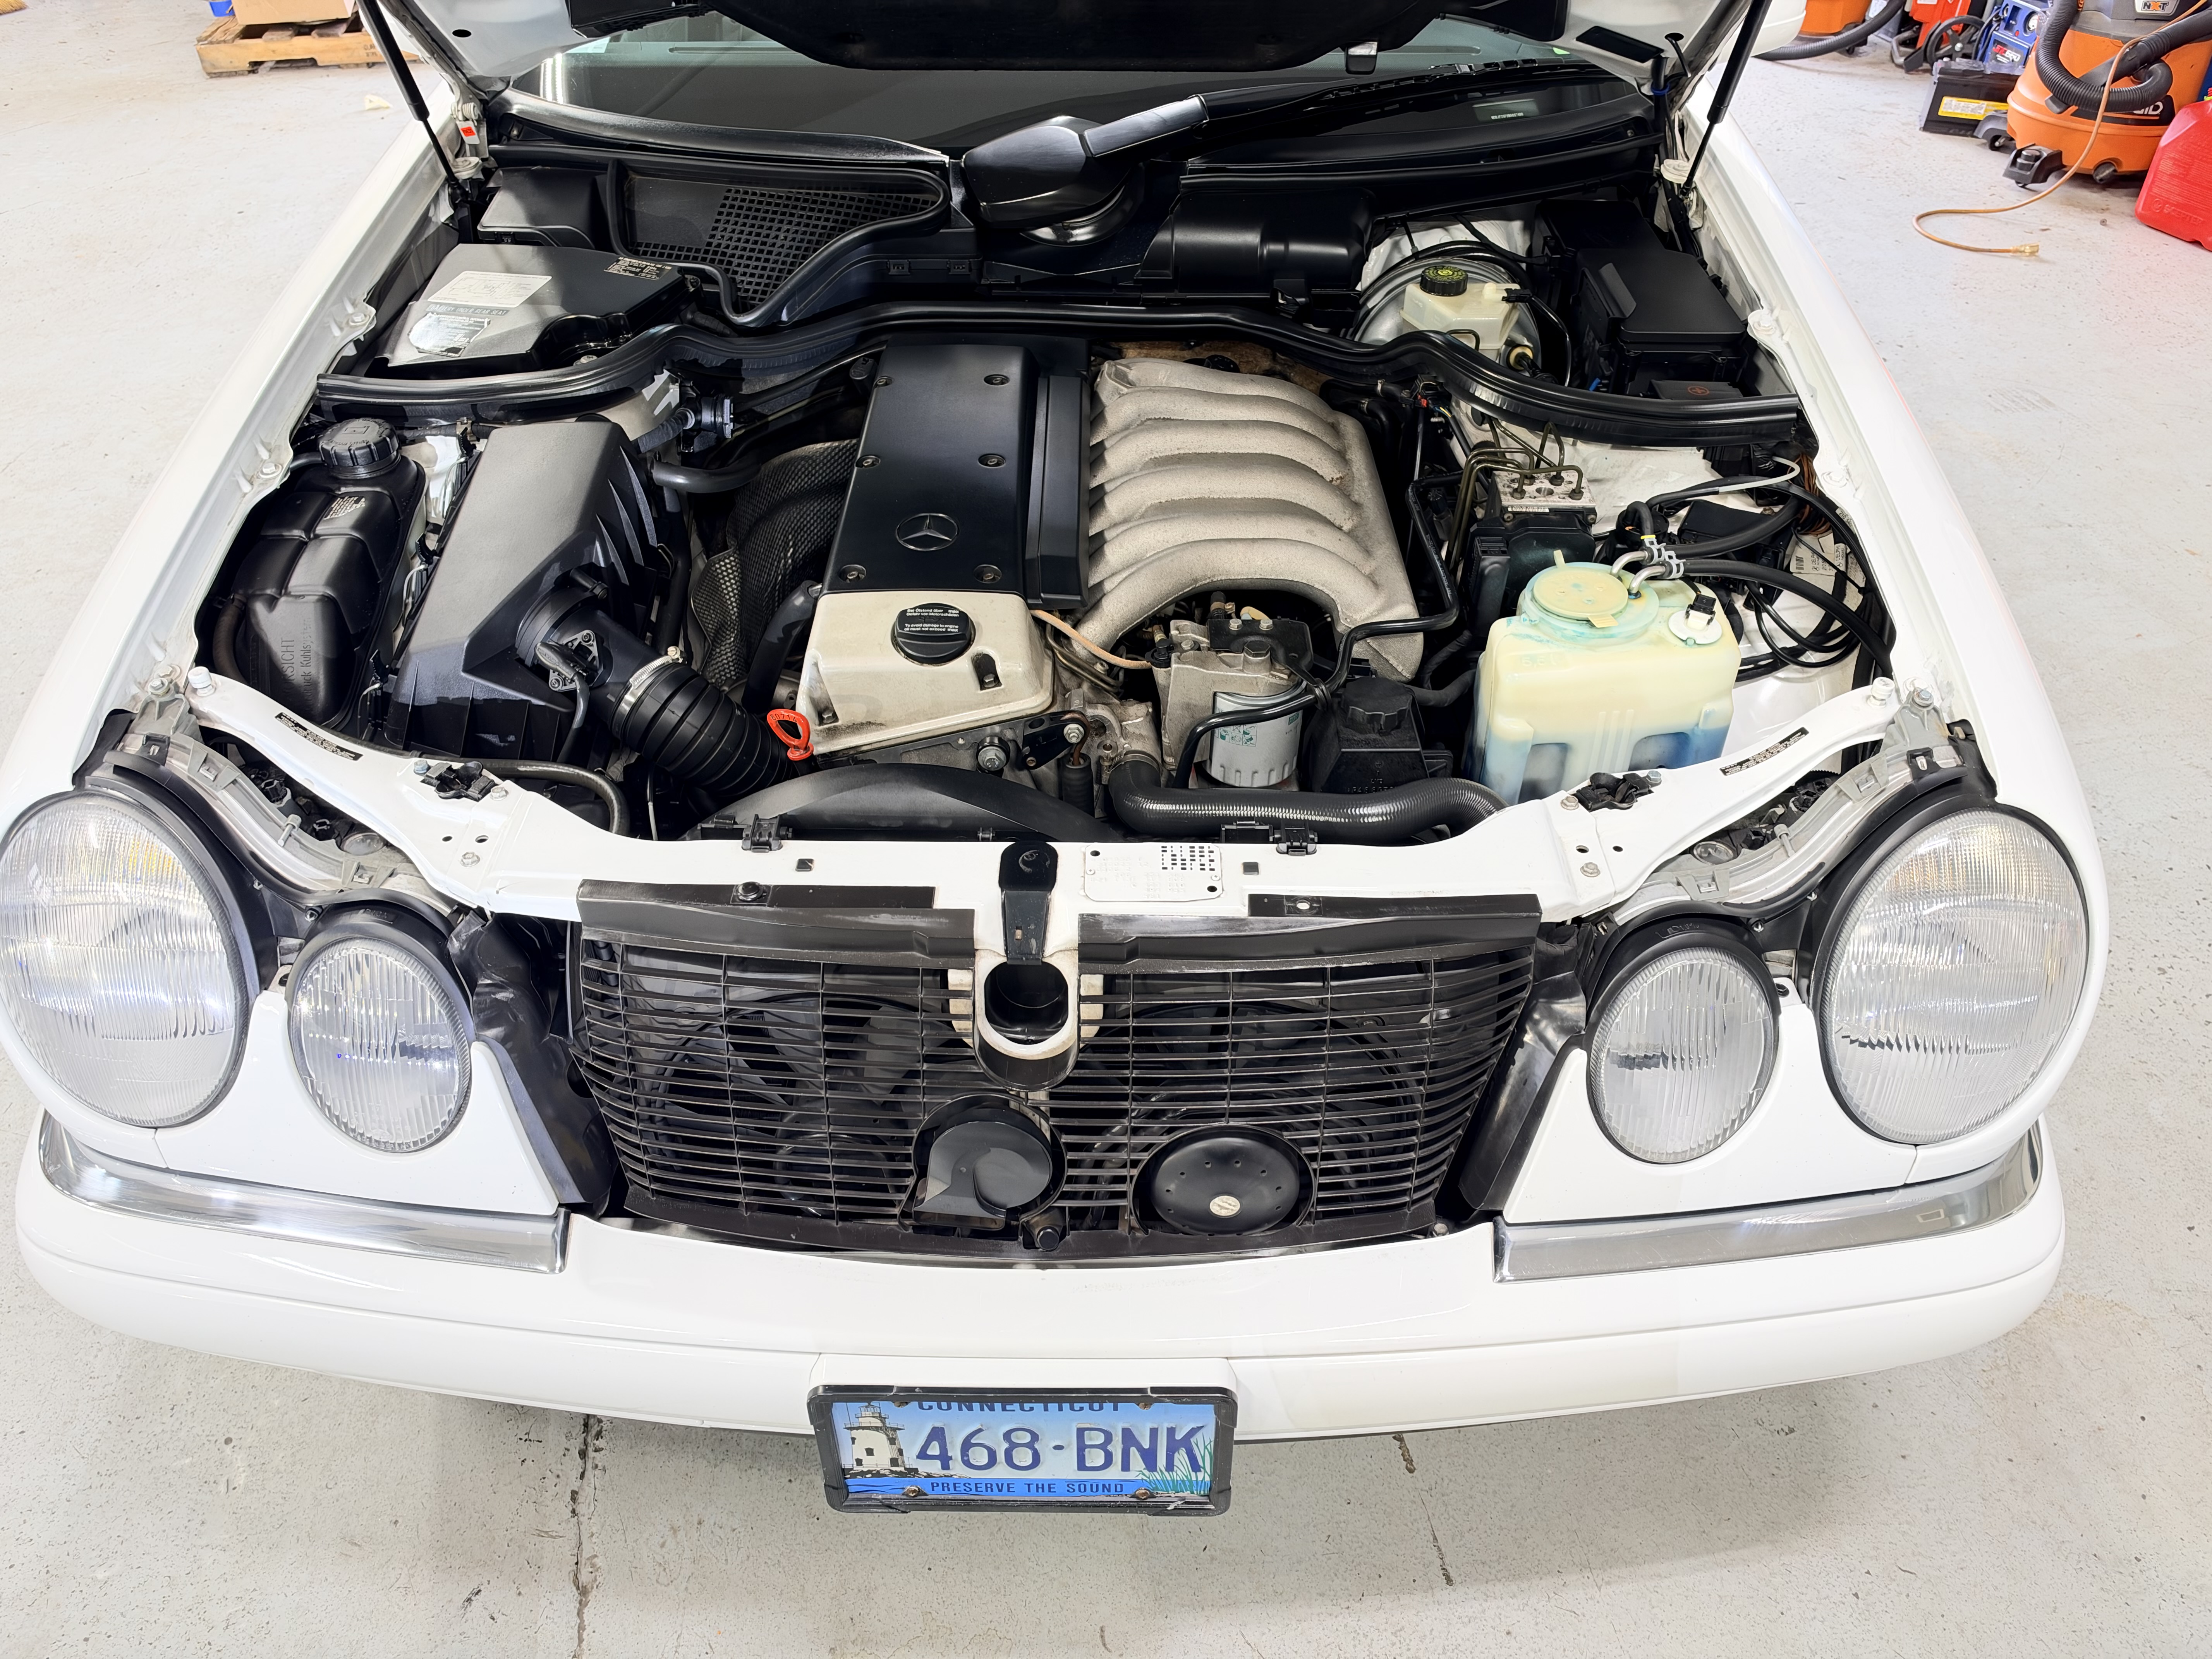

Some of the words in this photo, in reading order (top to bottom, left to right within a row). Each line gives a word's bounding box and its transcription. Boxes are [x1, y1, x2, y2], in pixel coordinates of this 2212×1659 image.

[2142, 1, 2169, 11] NXT
[931, 1482, 1016, 1493] PRESERVE
[1024, 1483, 1056, 1493] THE
[1066, 1483, 1124, 1493] SOUND
